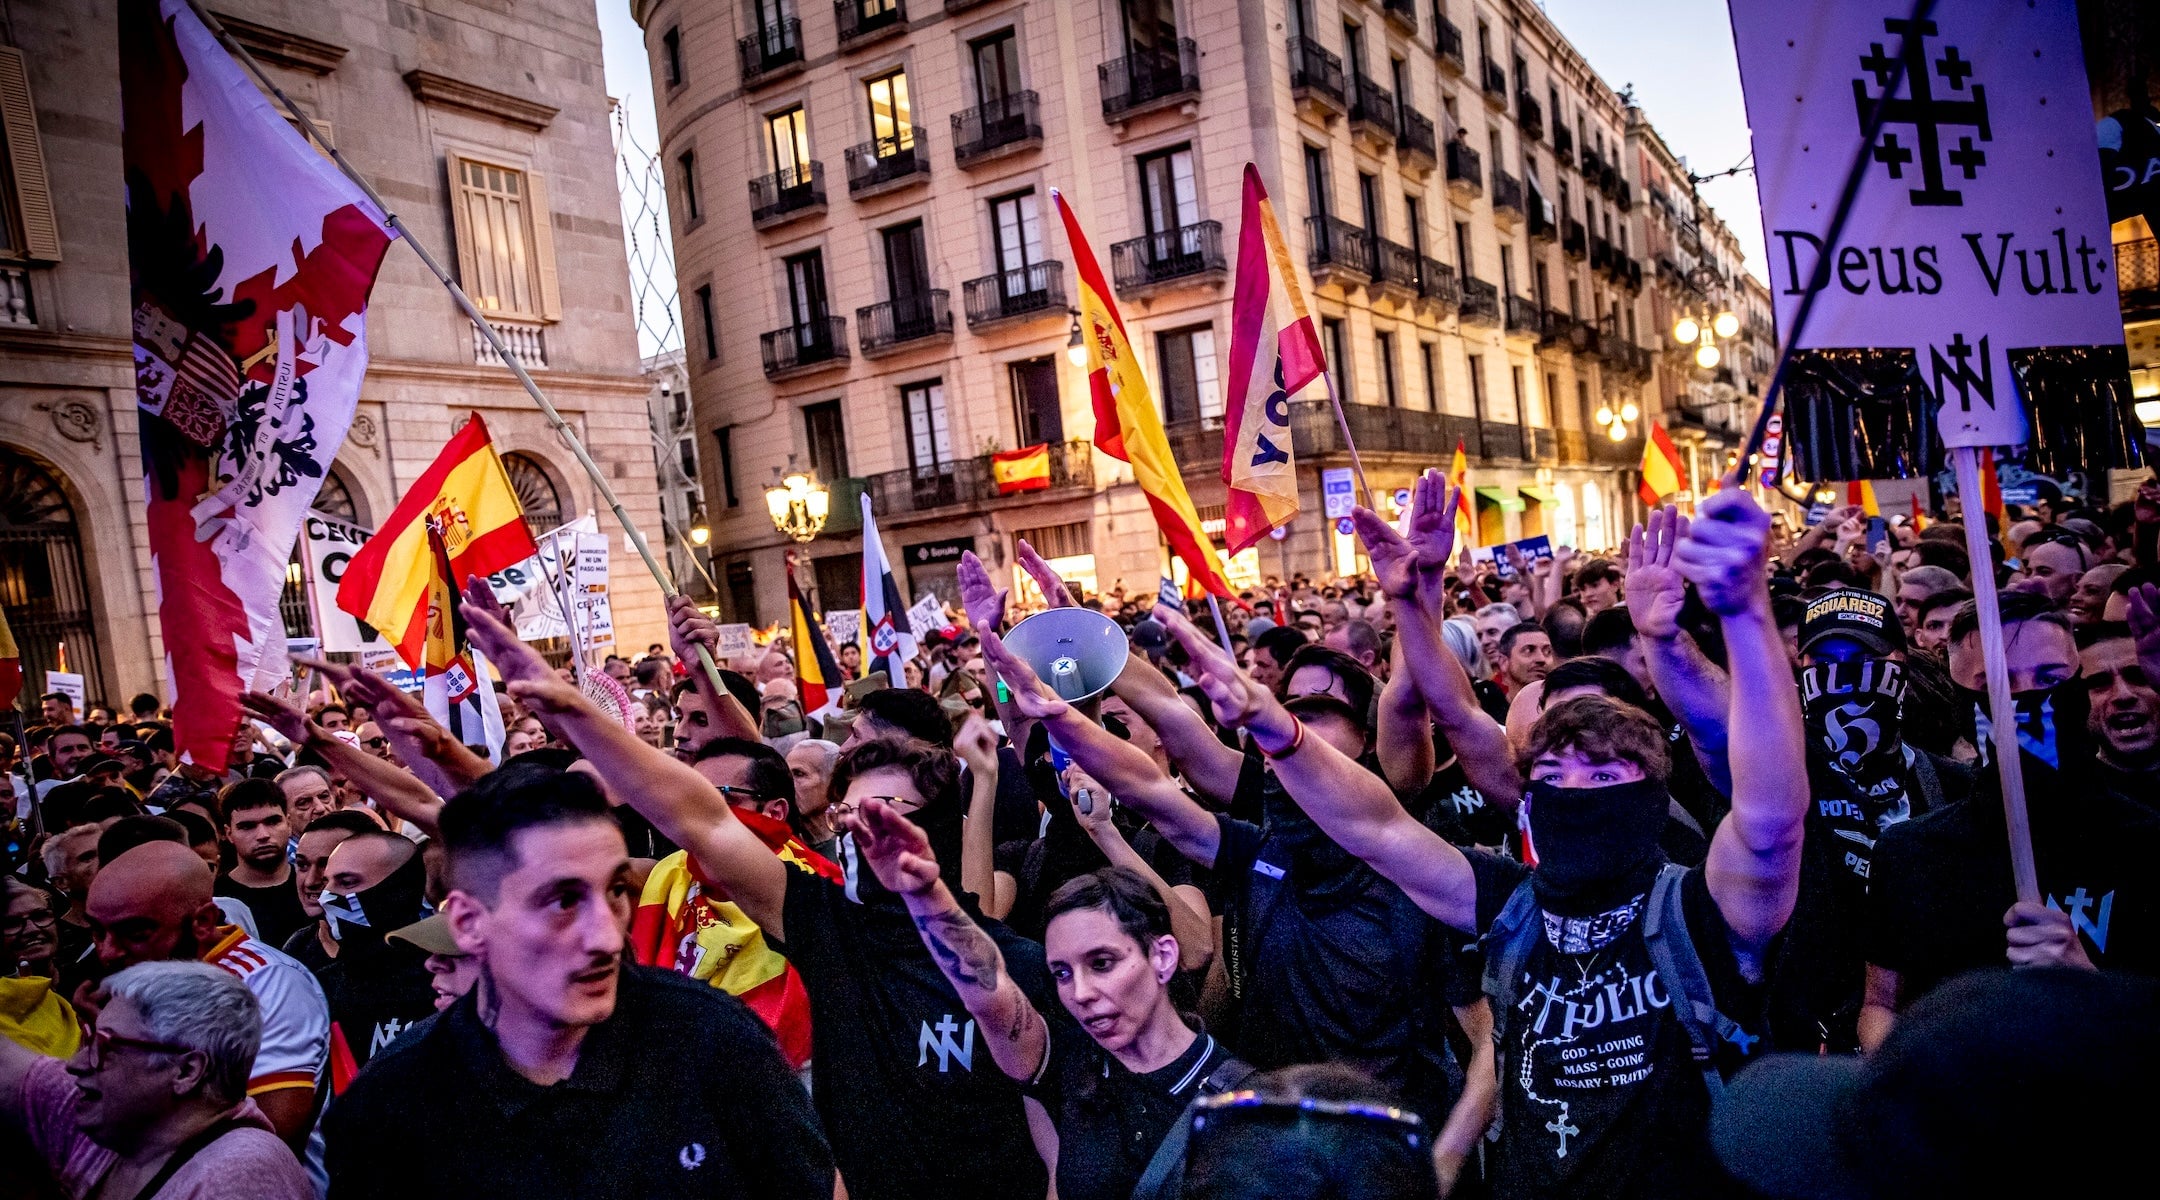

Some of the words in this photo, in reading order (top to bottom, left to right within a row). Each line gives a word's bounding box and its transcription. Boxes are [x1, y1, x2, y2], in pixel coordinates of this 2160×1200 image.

[1773, 229, 1943, 296] Deus
[306, 517, 375, 545] CEUT
[1806, 596, 1884, 624] DSQUARED2
[1561, 1046, 1588, 1061] GOD
[1597, 1035, 1644, 1055] LOVING
[1563, 1061, 1598, 1075] MASS
[1607, 1053, 1645, 1069] GOING
[1554, 1077, 1602, 1089] ROSARY
